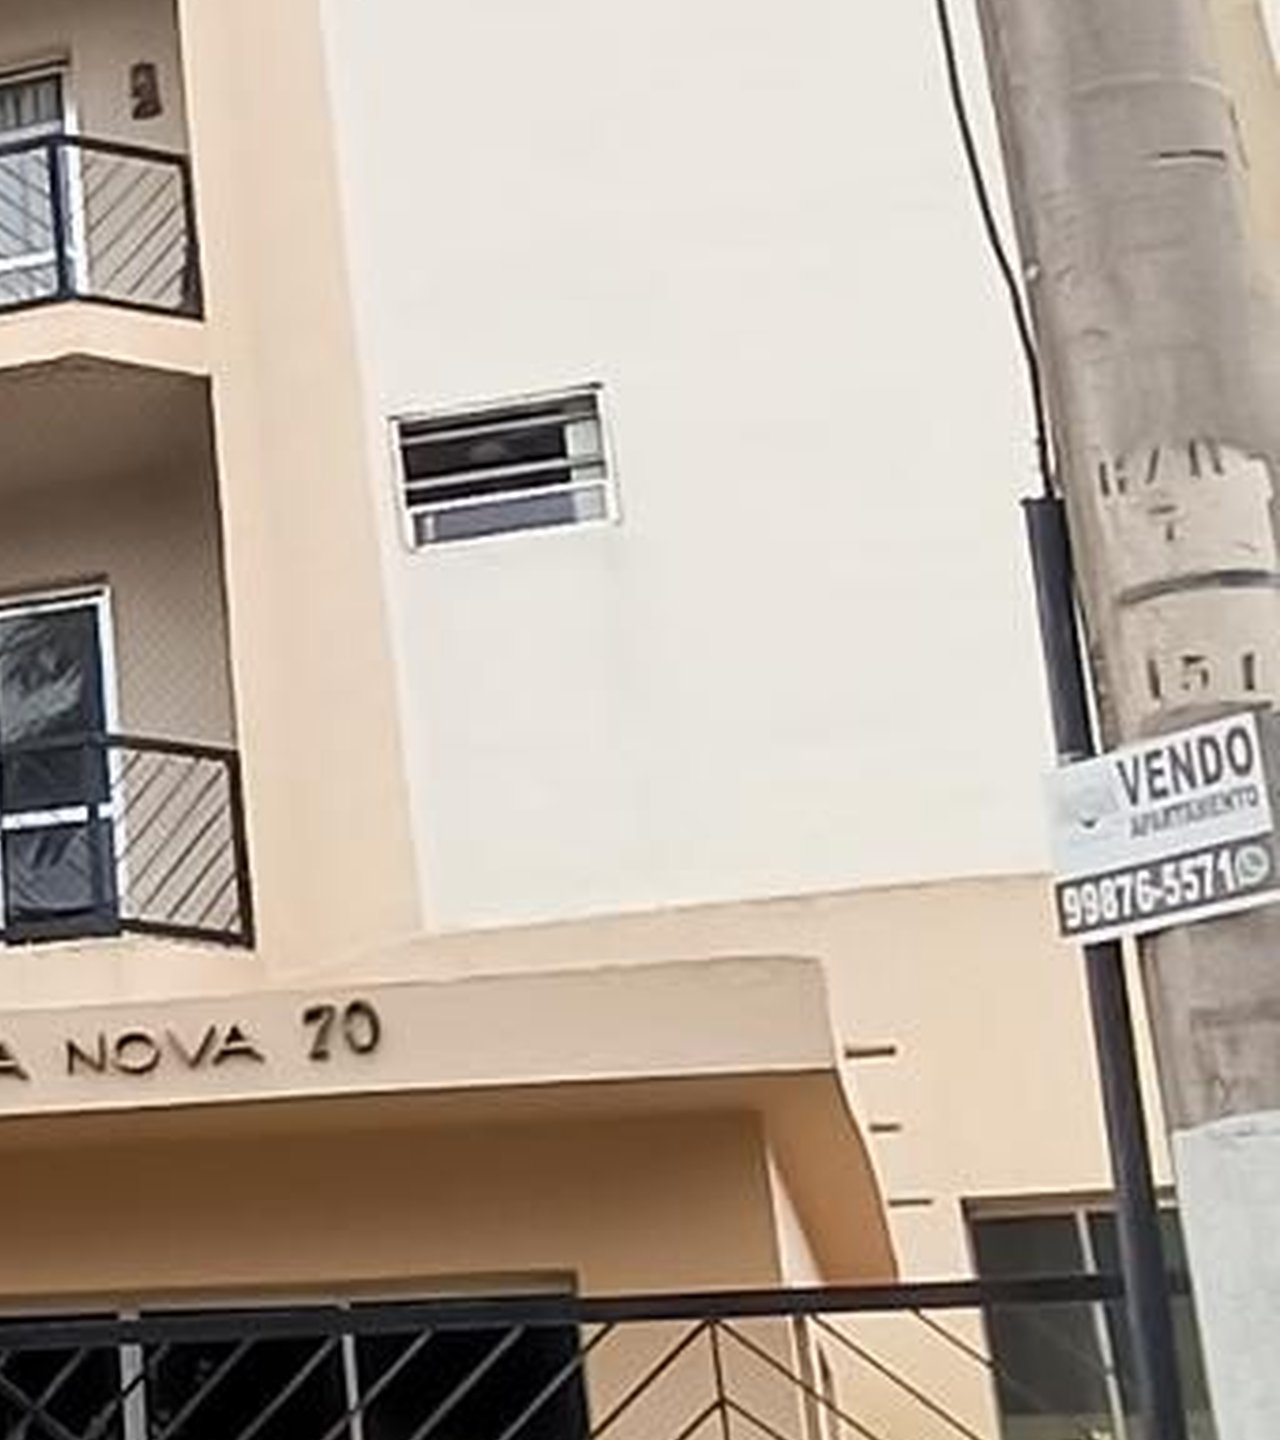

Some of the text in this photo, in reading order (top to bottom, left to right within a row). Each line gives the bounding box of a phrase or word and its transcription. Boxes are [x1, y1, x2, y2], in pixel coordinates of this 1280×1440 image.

[1116, 726, 1254, 806] VENDO
[1062, 849, 1237, 929] 99876-5571
[66, 1023, 265, 1075] NOVA
[302, 999, 382, 1061] 70
